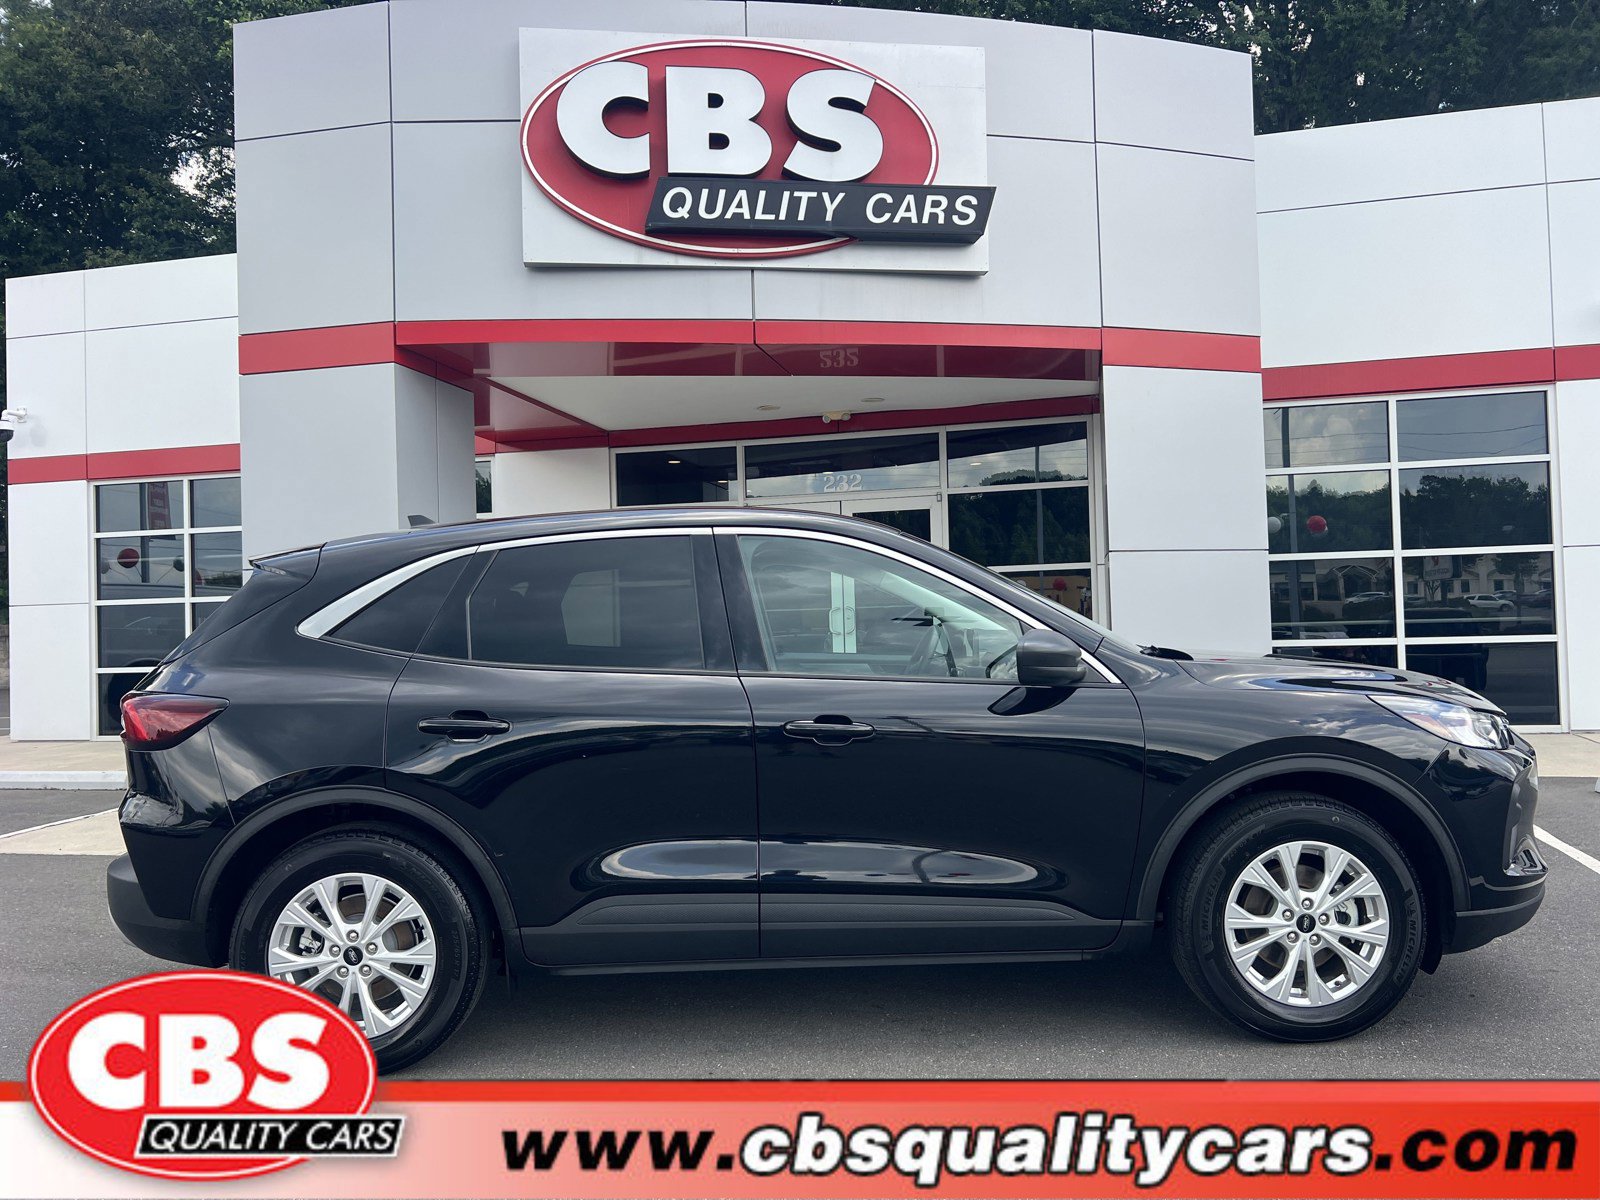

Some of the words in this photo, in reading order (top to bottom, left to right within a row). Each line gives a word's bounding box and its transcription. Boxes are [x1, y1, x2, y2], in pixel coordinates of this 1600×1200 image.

[556, 60, 884, 182] CBS
[662, 186, 845, 222] QUALITY
[865, 192, 979, 226] CARS
[823, 474, 862, 493] 232
[1396, 919, 1418, 982] MICHELIN
